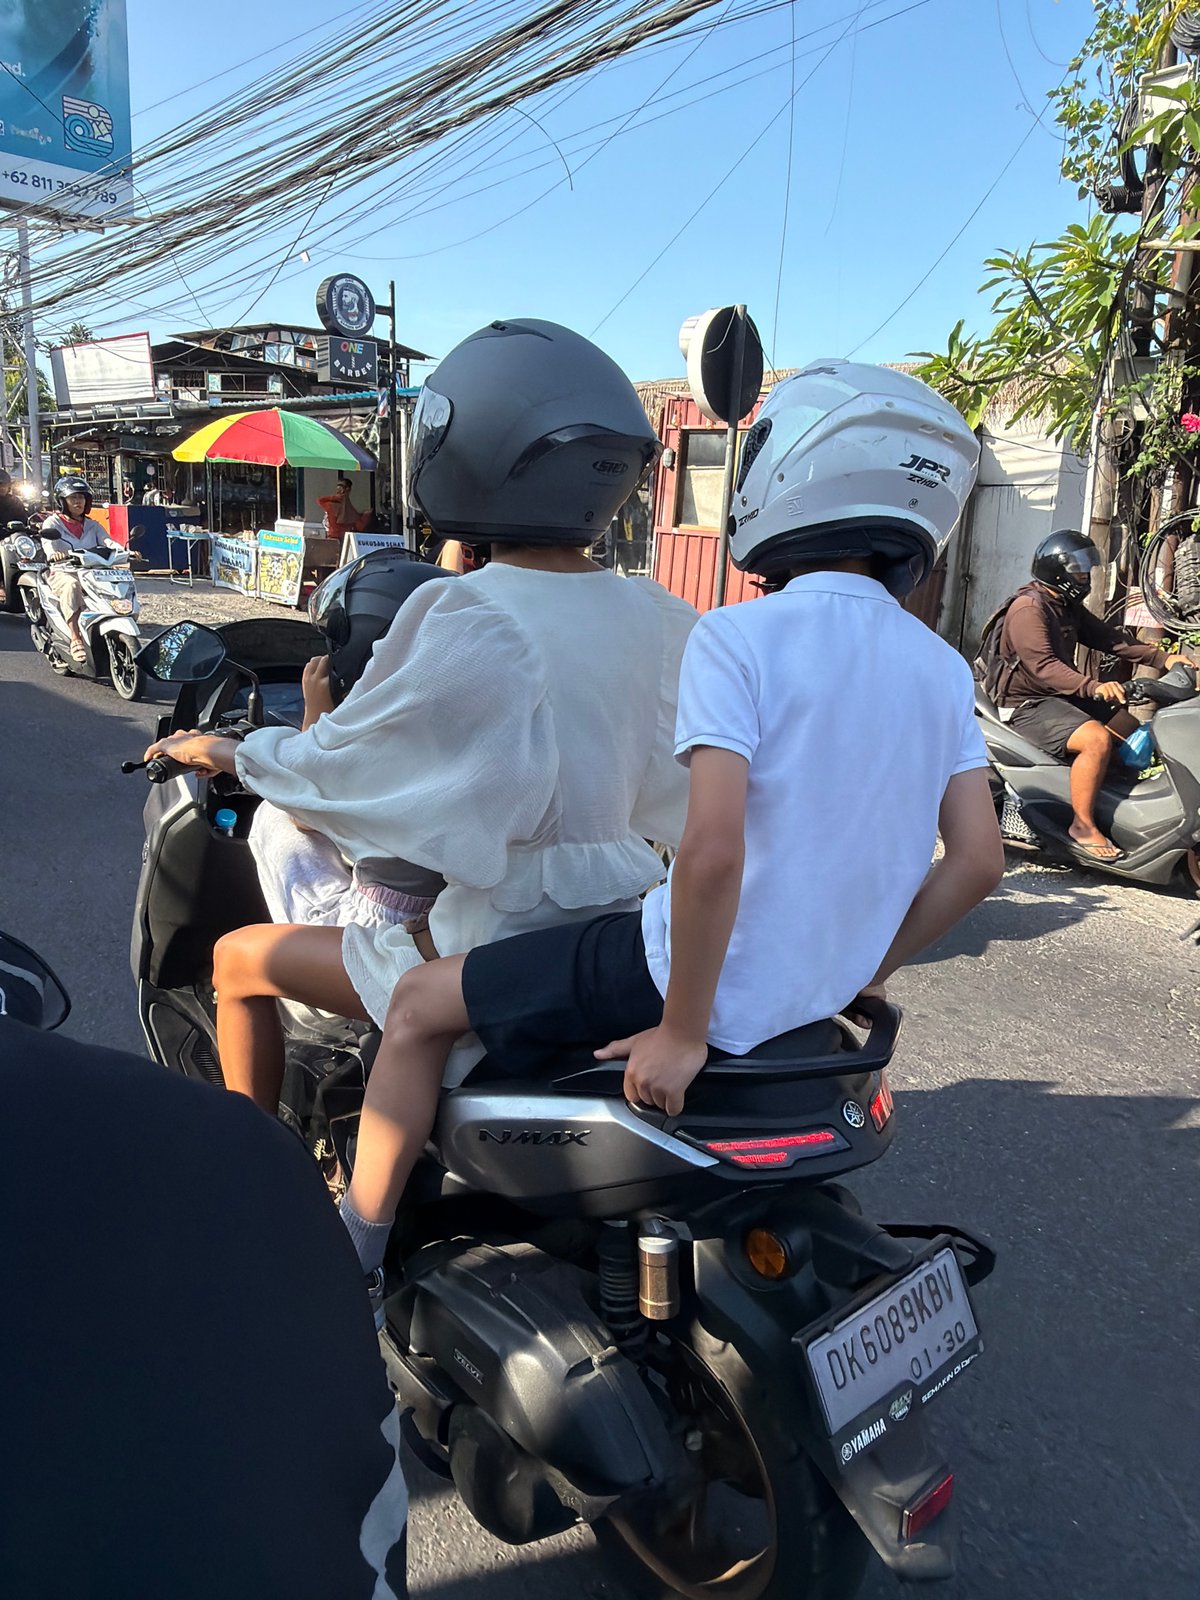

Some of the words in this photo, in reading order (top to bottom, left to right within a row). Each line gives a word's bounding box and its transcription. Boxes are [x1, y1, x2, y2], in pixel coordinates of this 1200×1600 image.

[2, 171, 28, 185] +62
[32, 174, 53, 191] 811
[340, 341, 364, 354] ONE
[333, 359, 373, 378] BARBER
[898, 453, 951, 483] JPR
[479, 1128, 592, 1146] NMAX
[921, 1371, 954, 1404] SEMAKIN
[851, 1417, 887, 1454] YAMAHA
